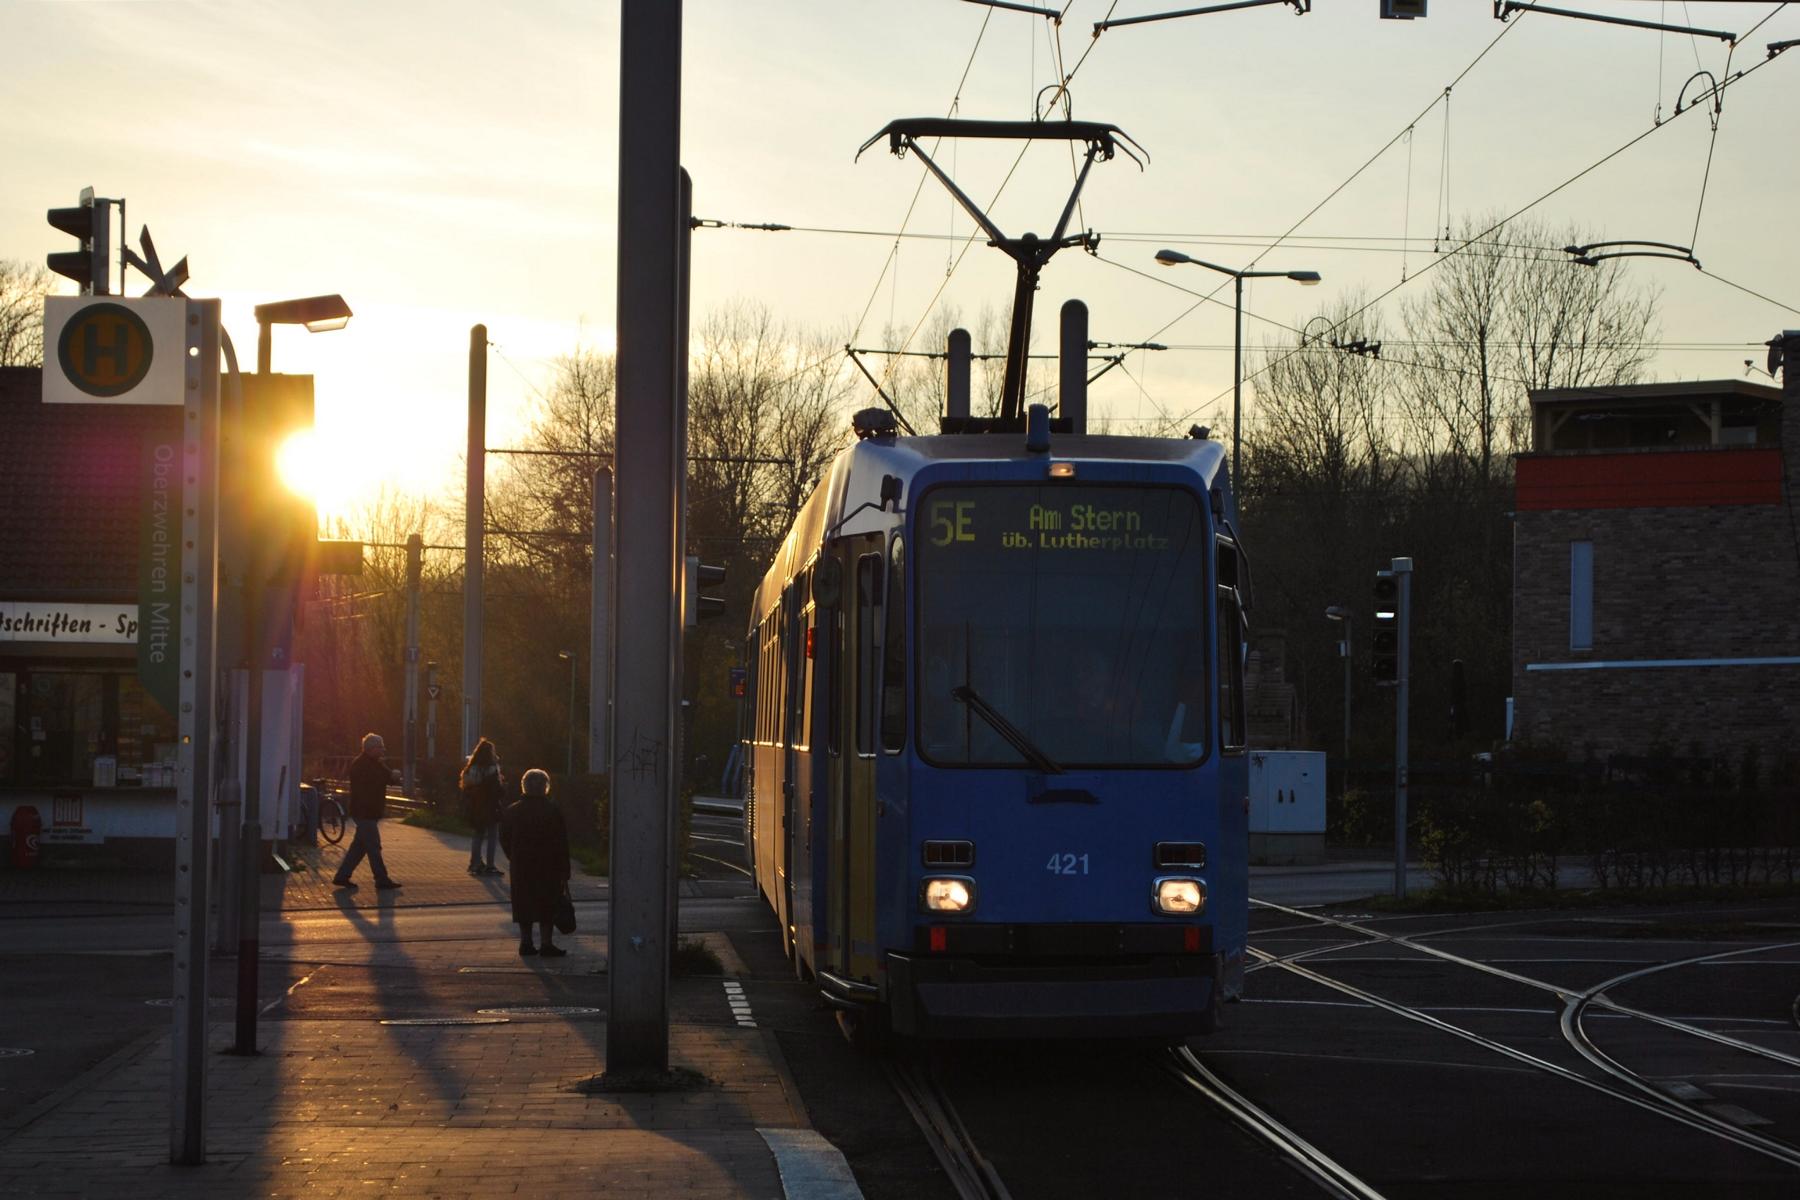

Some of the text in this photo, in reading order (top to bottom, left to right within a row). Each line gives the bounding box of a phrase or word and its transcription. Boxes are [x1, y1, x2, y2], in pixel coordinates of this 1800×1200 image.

[83, 323, 127, 376] H
[931, 501, 976, 546] 5E
[1029, 504, 1141, 530] Am Stern
[149, 443, 174, 665] Oberzwehren Mitte
[1002, 531, 1169, 551] üb. Lutherplatz
[1046, 852, 1089, 875] 421
